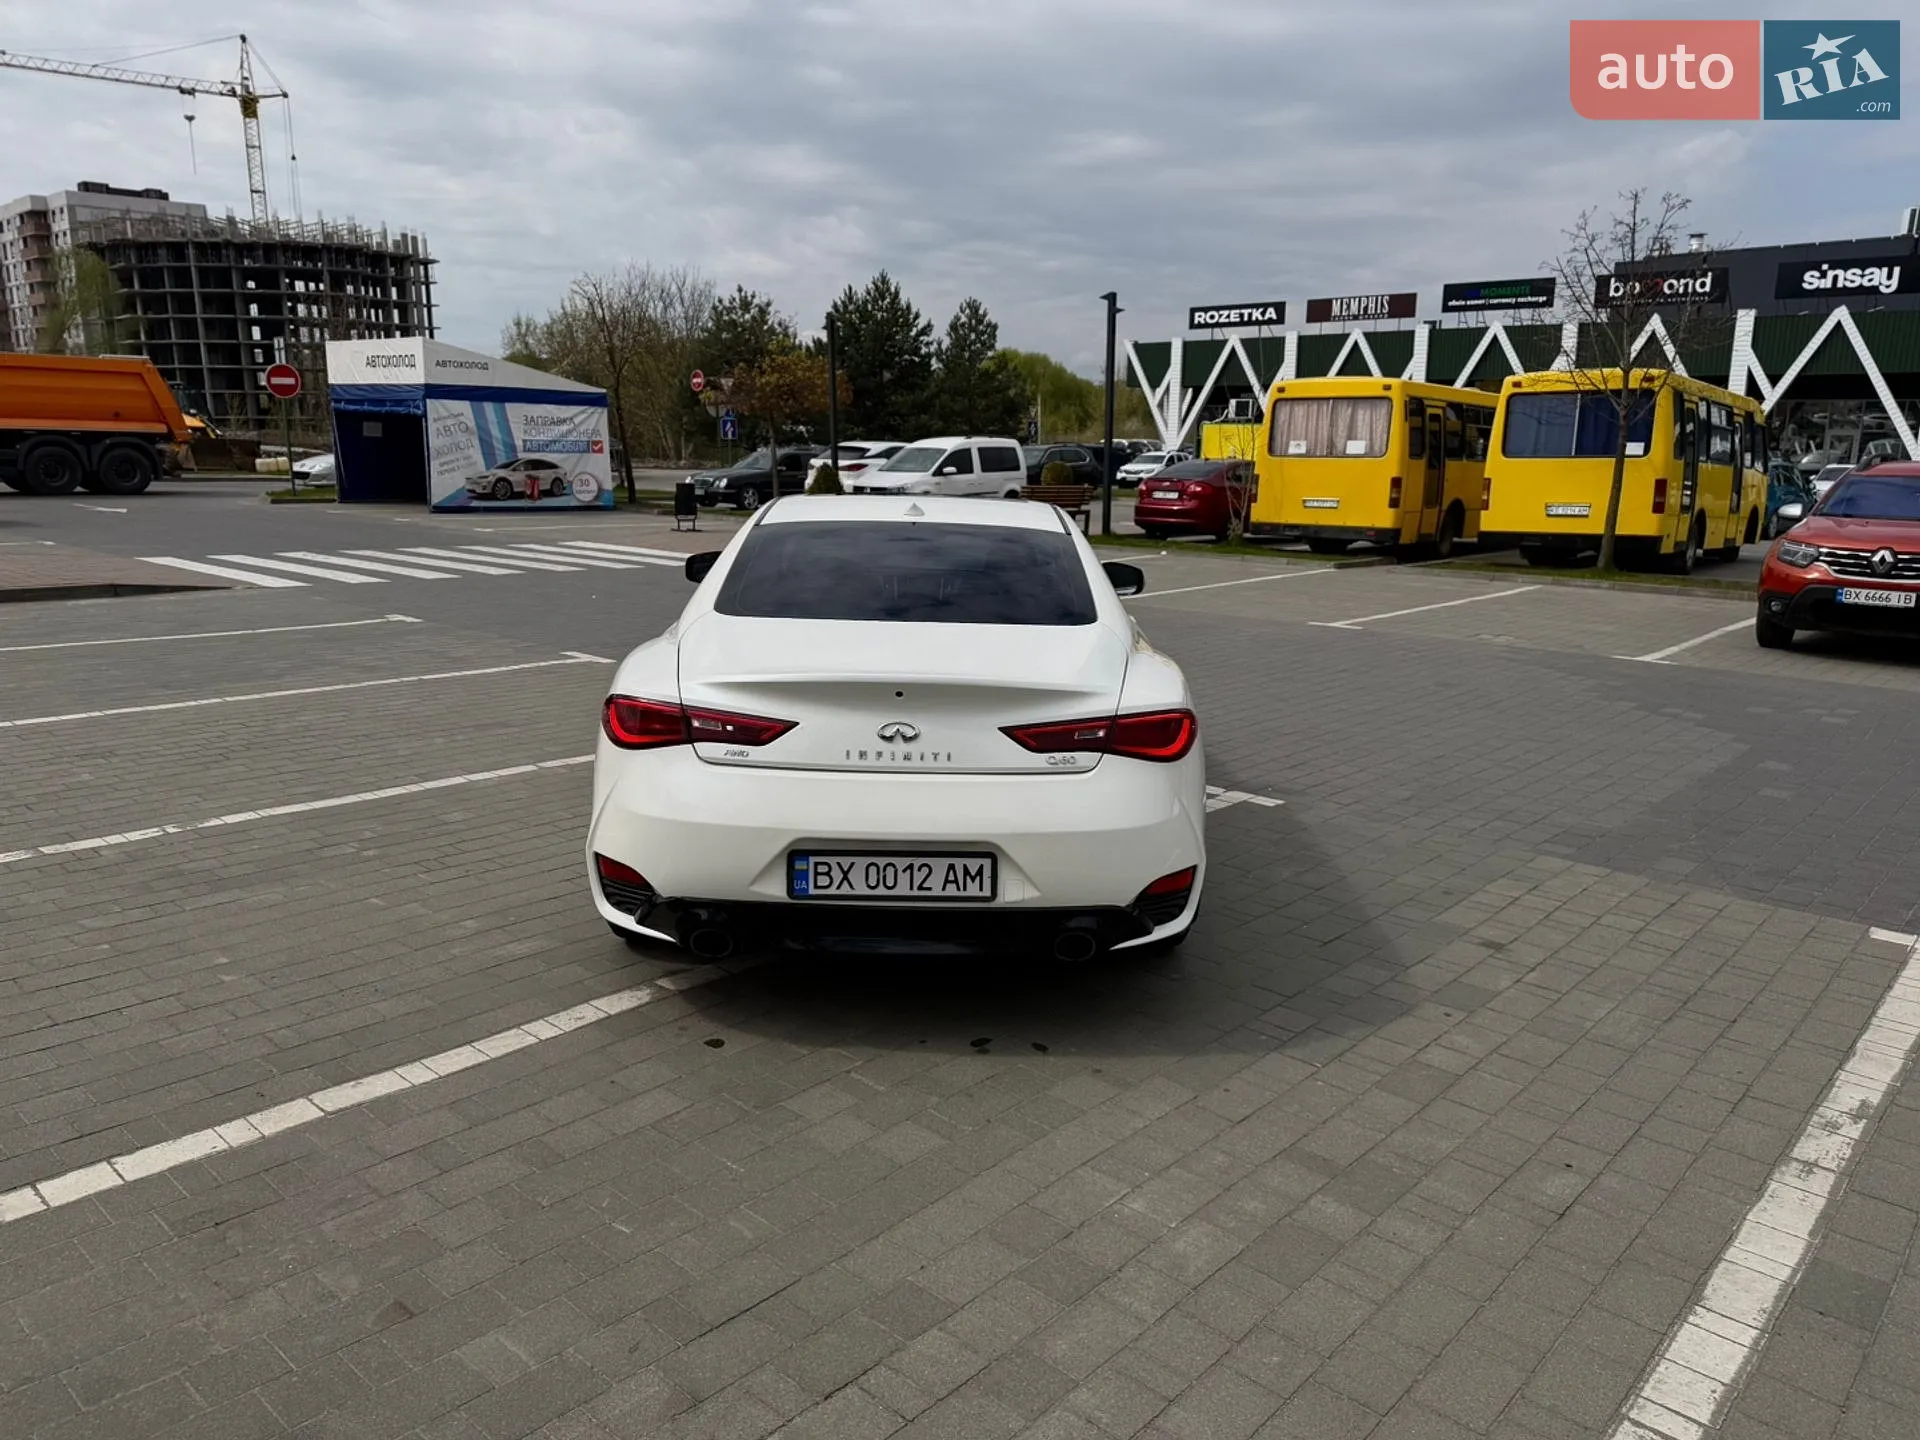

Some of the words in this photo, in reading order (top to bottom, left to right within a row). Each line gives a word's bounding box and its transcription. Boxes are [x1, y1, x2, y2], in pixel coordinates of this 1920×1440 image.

[1801, 263, 1901, 294] sinsay
[1331, 295, 1390, 316] MEMPHIS
[1194, 307, 1278, 324] ROZETKA
[365, 353, 416, 369] АВТОХОЛОД
[435, 359, 489, 371] АВТОХОЛОД
[436, 421, 469, 439] АВТО
[1844, 589, 1861, 601] BX
[1864, 591, 1892, 603] 6666
[846, 750, 952, 763] INFINITI
[1045, 755, 1077, 765] Q60
[813, 861, 856, 890] BX
[865, 862, 933, 891] 0012
[941, 862, 984, 892] AM
[794, 880, 808, 890] UA
